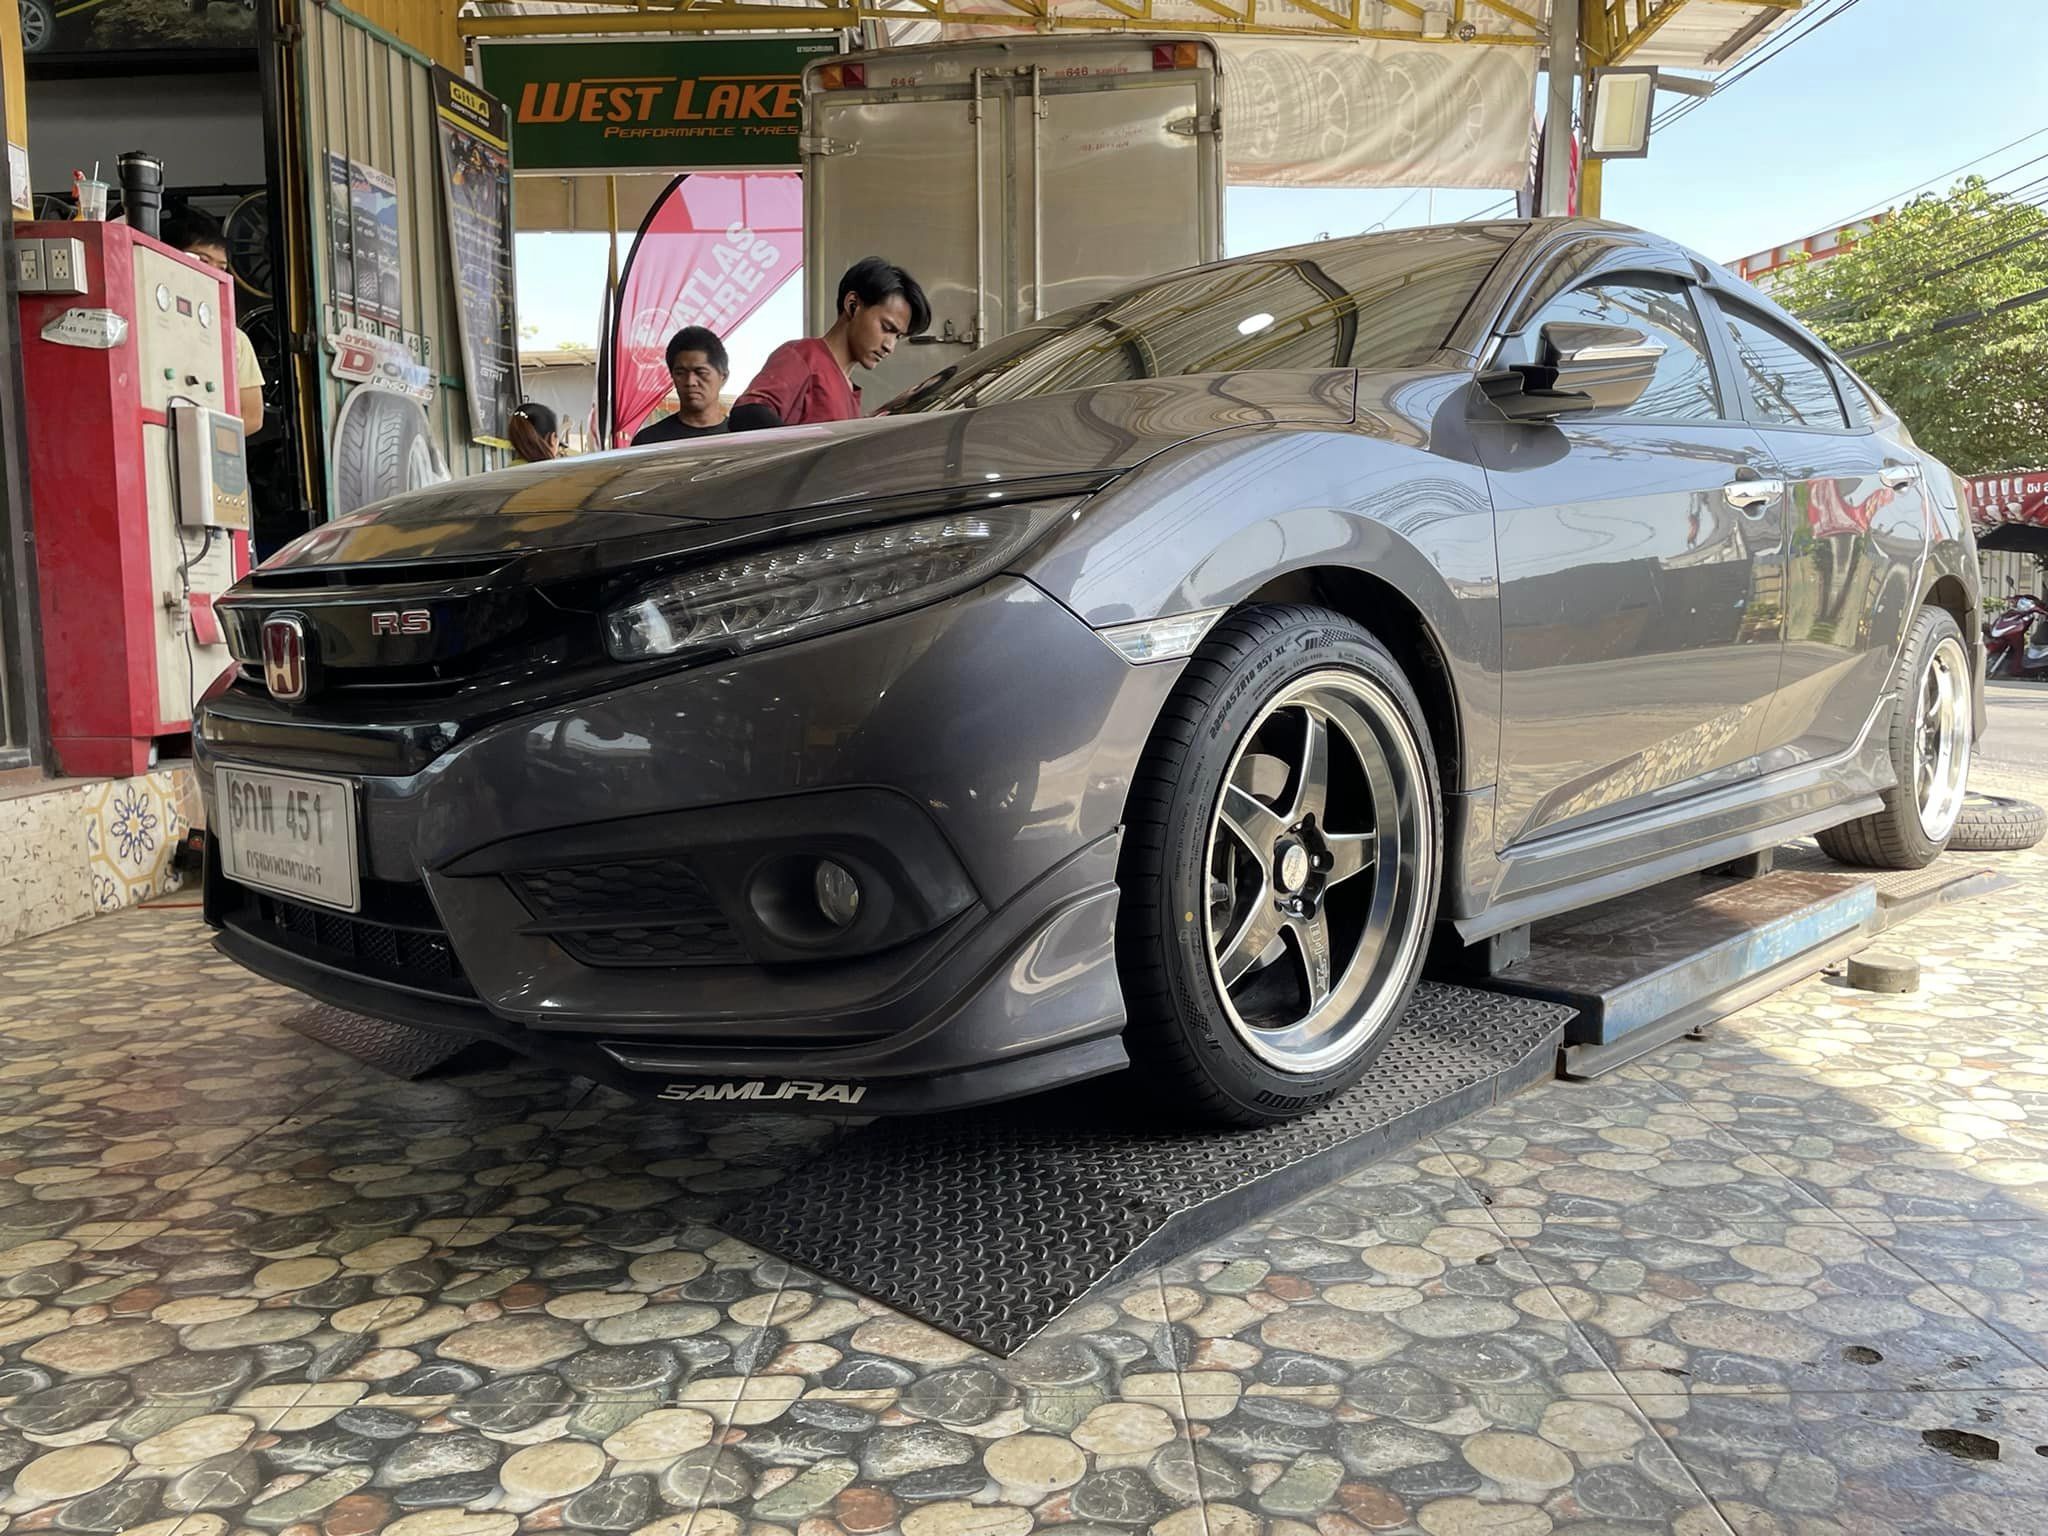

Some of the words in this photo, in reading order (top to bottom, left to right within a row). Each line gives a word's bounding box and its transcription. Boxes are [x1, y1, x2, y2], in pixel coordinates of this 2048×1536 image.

[517, 81, 662, 123] WEST
[673, 80, 800, 120] LAKE
[604, 126, 735, 139] PERFORMANCE
[743, 125, 799, 136] TYRES
[671, 221, 755, 331] ATLAS
[371, 609, 431, 635] RS
[657, 1081, 867, 1104] SAMURAI
